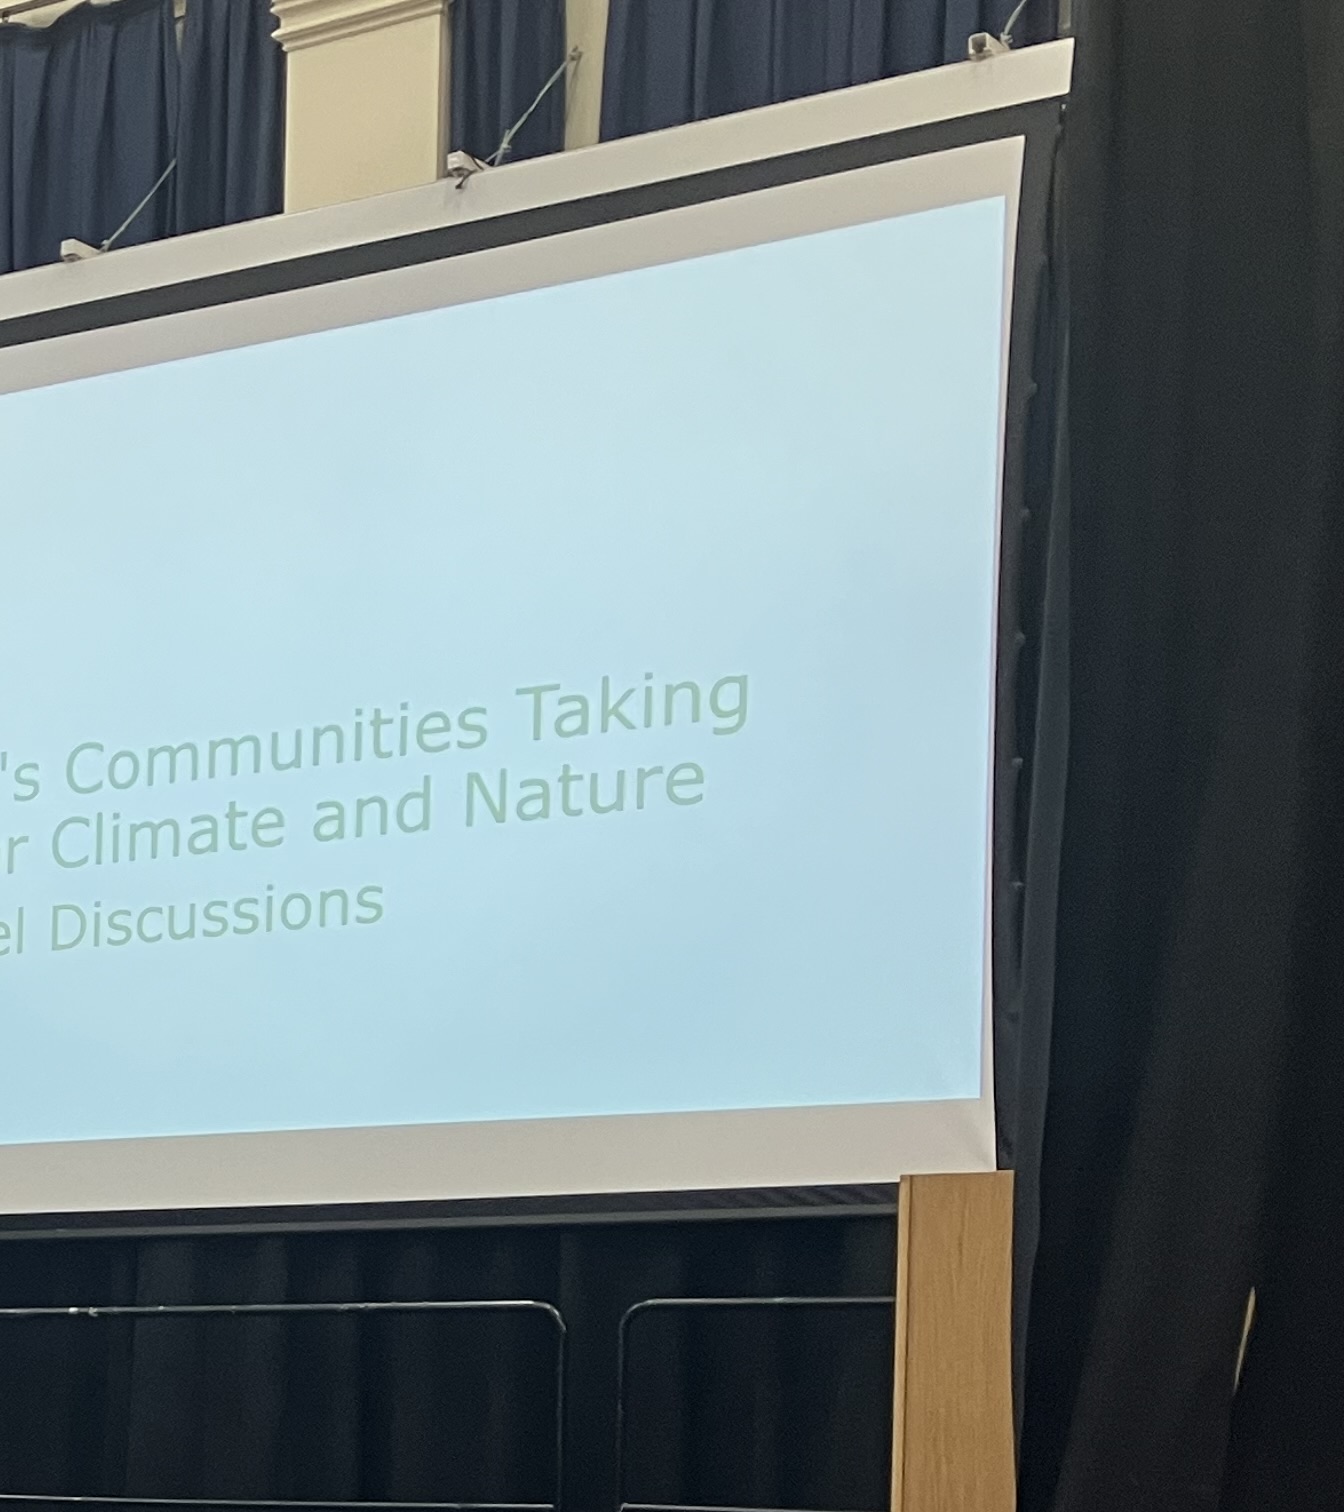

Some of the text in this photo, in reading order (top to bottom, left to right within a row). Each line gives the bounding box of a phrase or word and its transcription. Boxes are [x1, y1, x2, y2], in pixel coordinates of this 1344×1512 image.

[64, 701, 489, 795] Communities
[514, 672, 749, 741] Taking
[51, 800, 285, 869] Climate
[312, 775, 431, 843] and
[464, 760, 705, 828] Nature
[50, 883, 384, 952] Discussions
